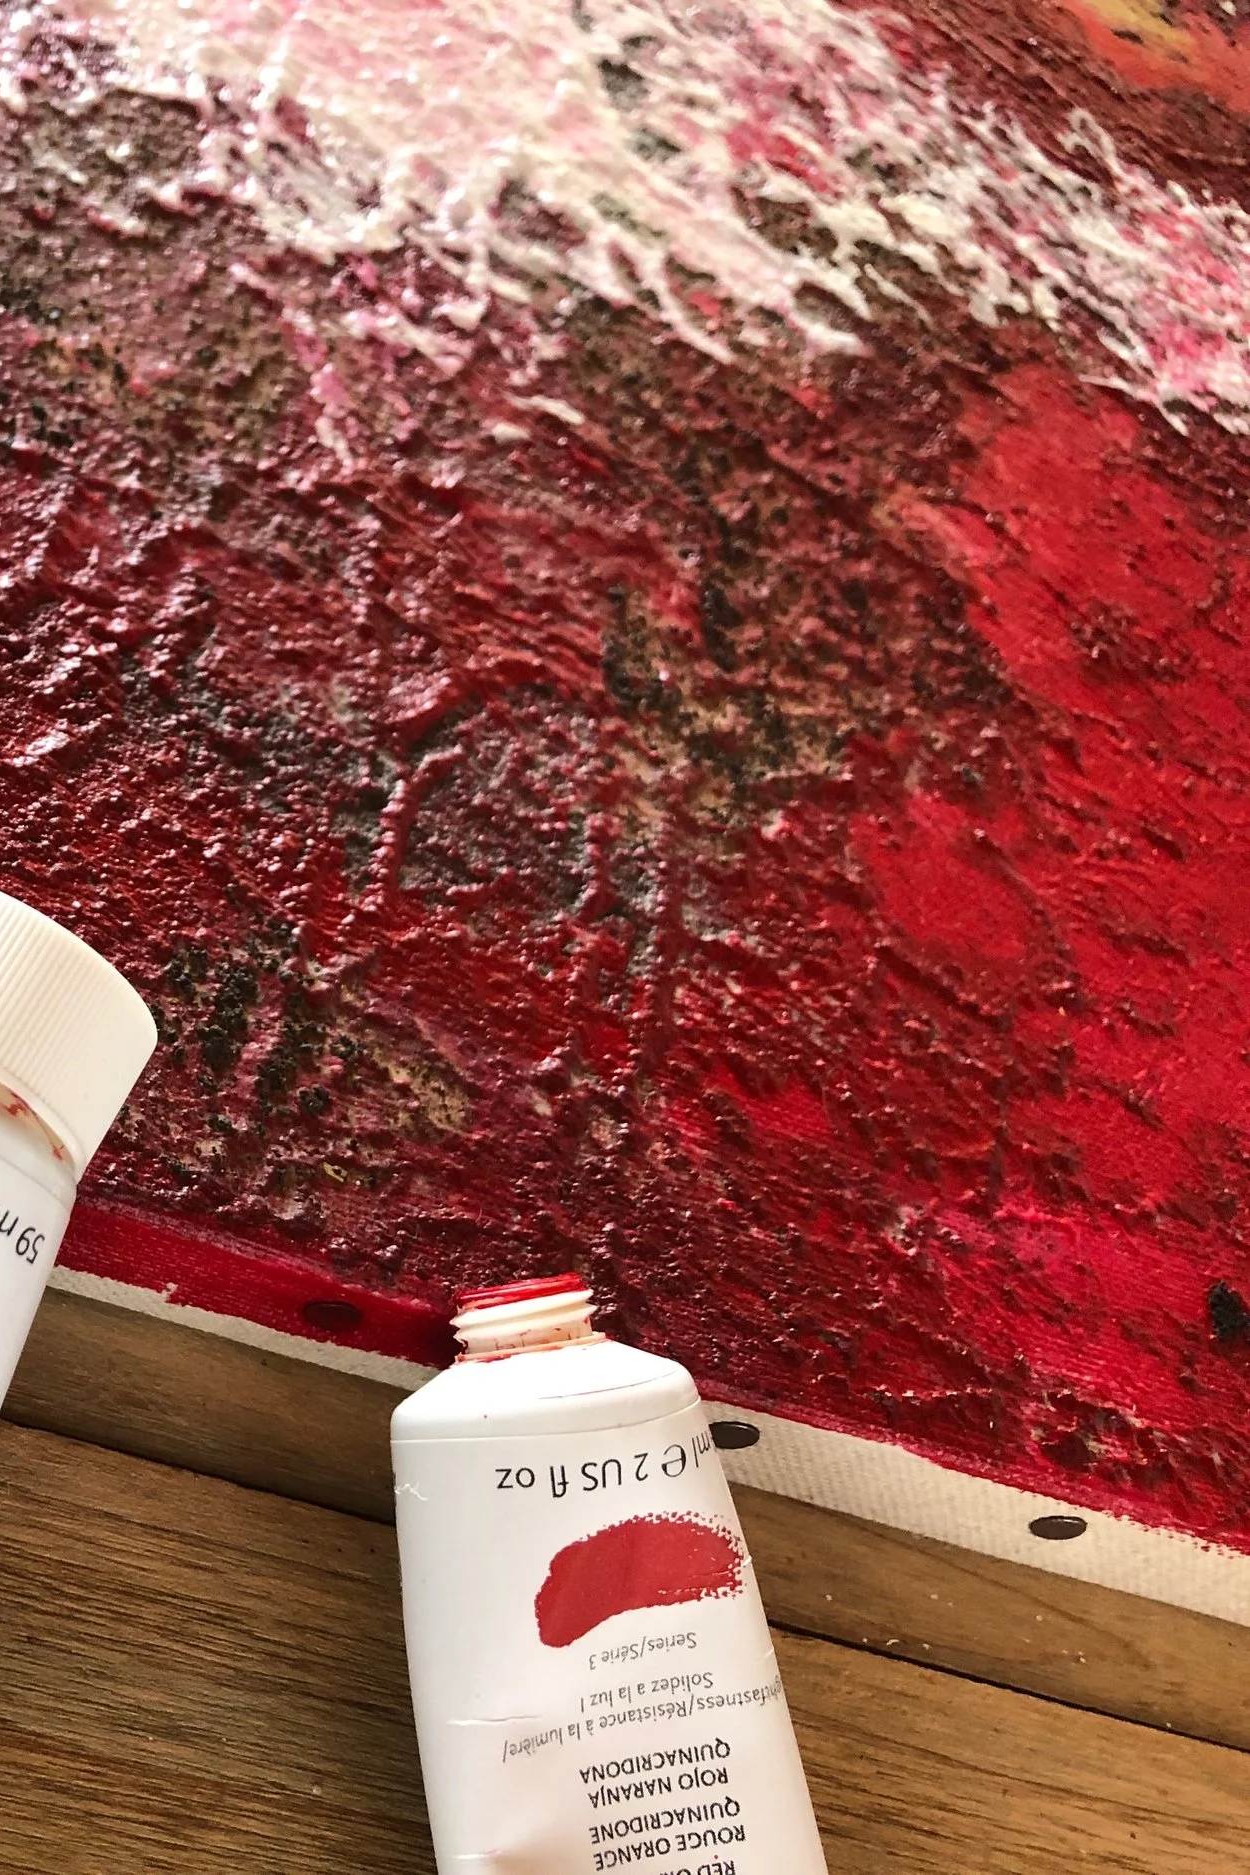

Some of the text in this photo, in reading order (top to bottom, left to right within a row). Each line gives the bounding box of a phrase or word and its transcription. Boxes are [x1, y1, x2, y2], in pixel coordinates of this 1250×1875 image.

[495, 1467, 536, 1489] oz
[580, 1458, 622, 1492] US
[633, 1452, 649, 1482] 2
[549, 1465, 570, 1498] fl
[588, 1653, 597, 1671] 3
[618, 1685, 632, 1704] la
[636, 1682, 646, 1696] a
[651, 1671, 714, 1695] Solidez
[589, 1689, 614, 1708] luz
[567, 1722, 581, 1741] la
[585, 1719, 594, 1736] à
[579, 1737, 731, 1785] QUINACRIDONA
[587, 1766, 729, 1809] ROJO NARANJA
[588, 1795, 741, 1845] QUINACRIDONE
[593, 1824, 746, 1872] ROUGE ORANGE
